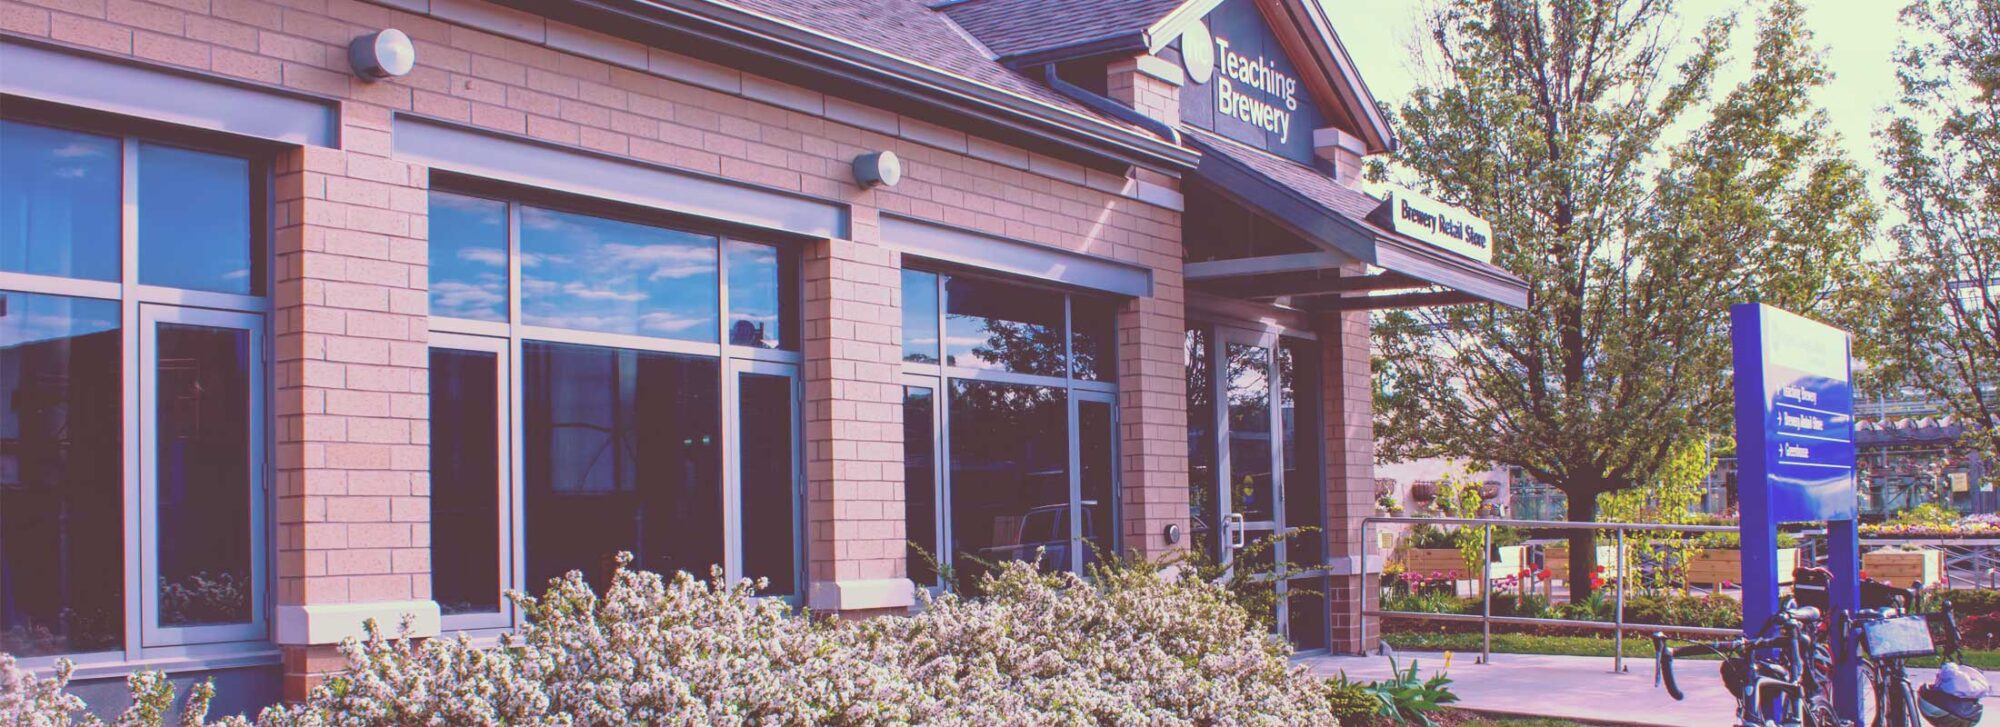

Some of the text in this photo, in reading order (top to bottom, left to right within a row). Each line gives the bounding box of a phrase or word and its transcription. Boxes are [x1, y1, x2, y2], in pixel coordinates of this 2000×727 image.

[1215, 37, 1297, 110] Teaching
[1218, 77, 1289, 144] Brewery
[1401, 198, 1486, 248] Brewery Retail Store
